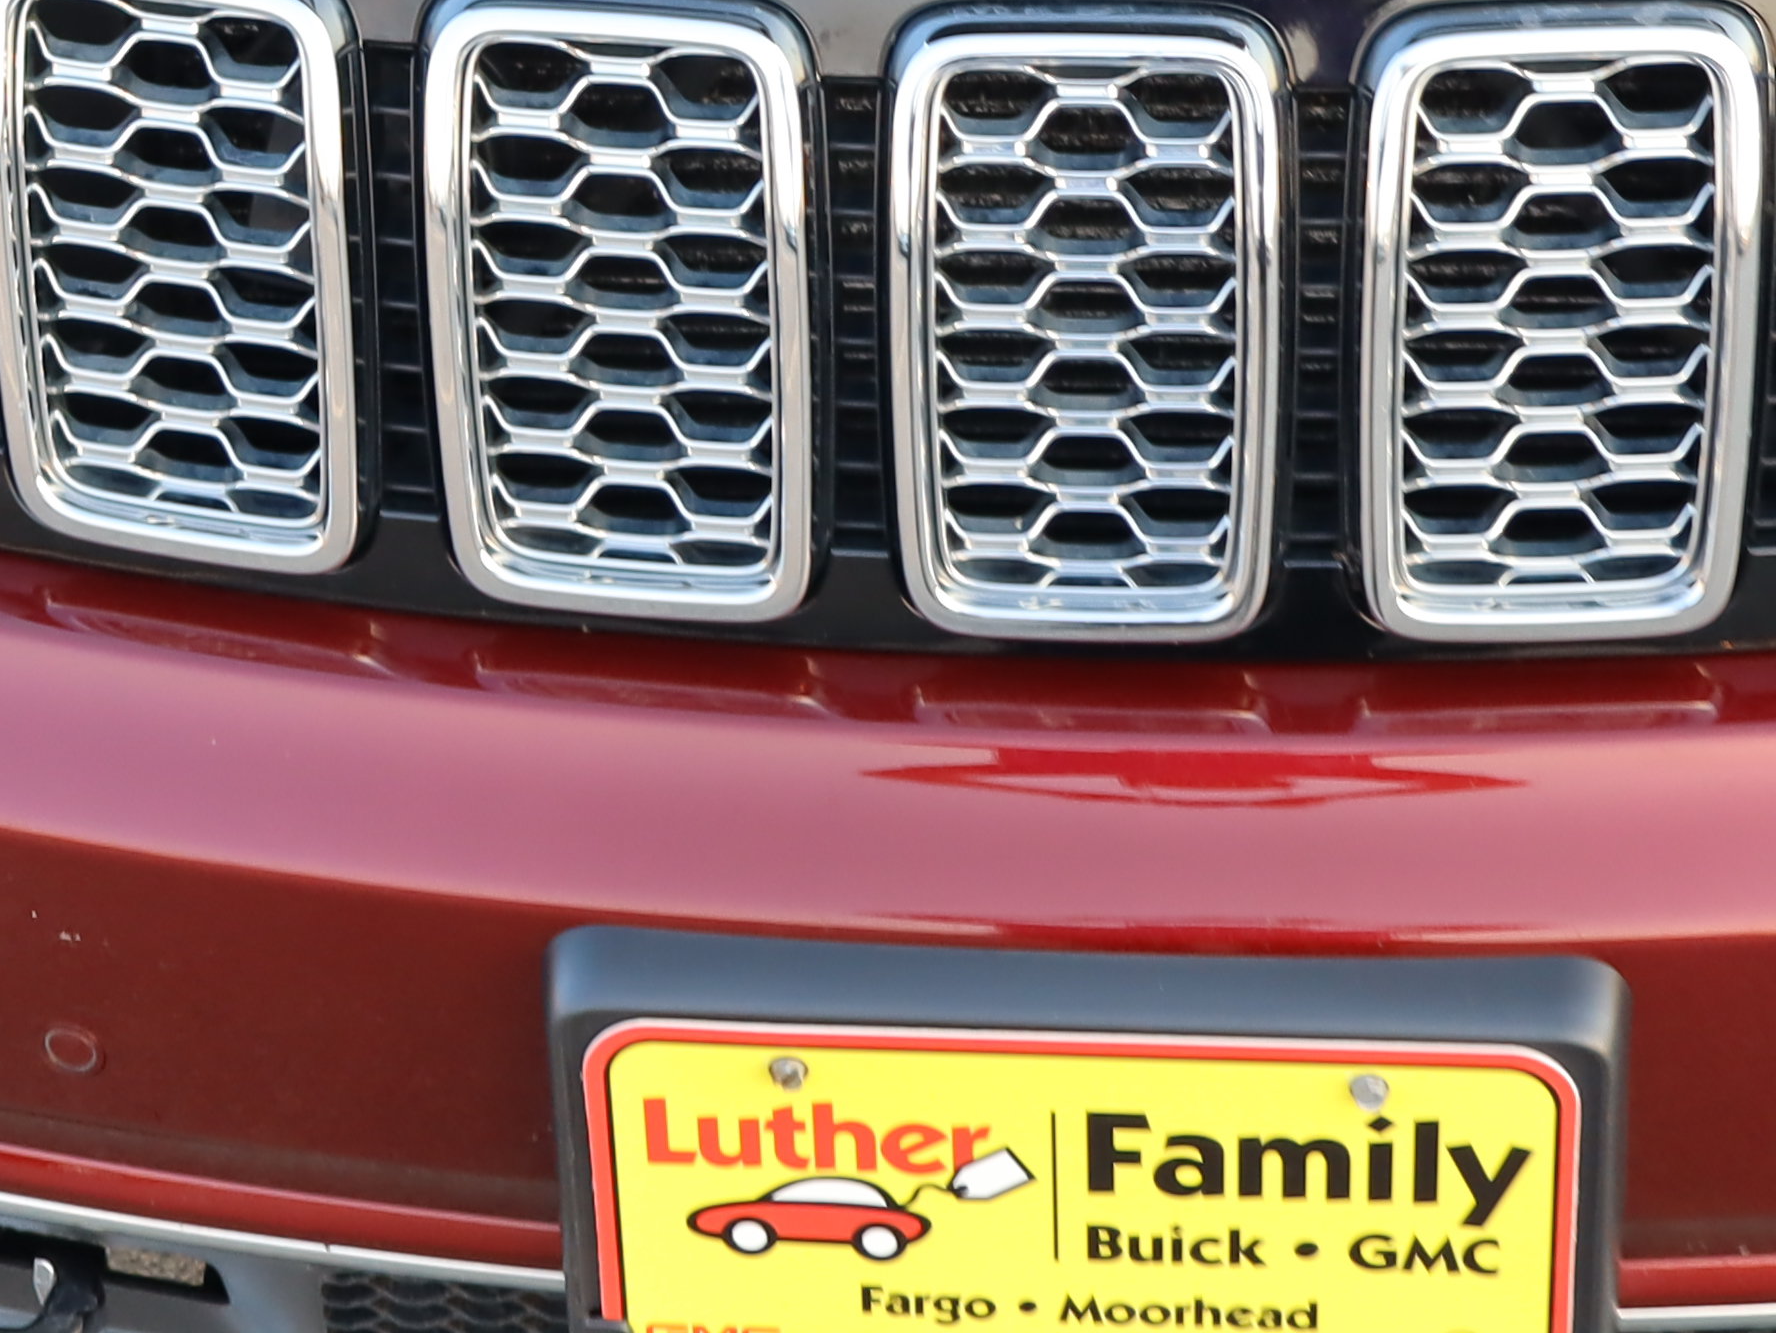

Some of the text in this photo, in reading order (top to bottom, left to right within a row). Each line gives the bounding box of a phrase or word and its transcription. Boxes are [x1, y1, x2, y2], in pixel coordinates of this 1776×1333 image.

[643, 1097, 992, 1176] Luther
[1086, 1111, 1533, 1227] Family
[1086, 1224, 1501, 1275] Buick GMC
[859, 1283, 1319, 1331] Fargo Moorhead
